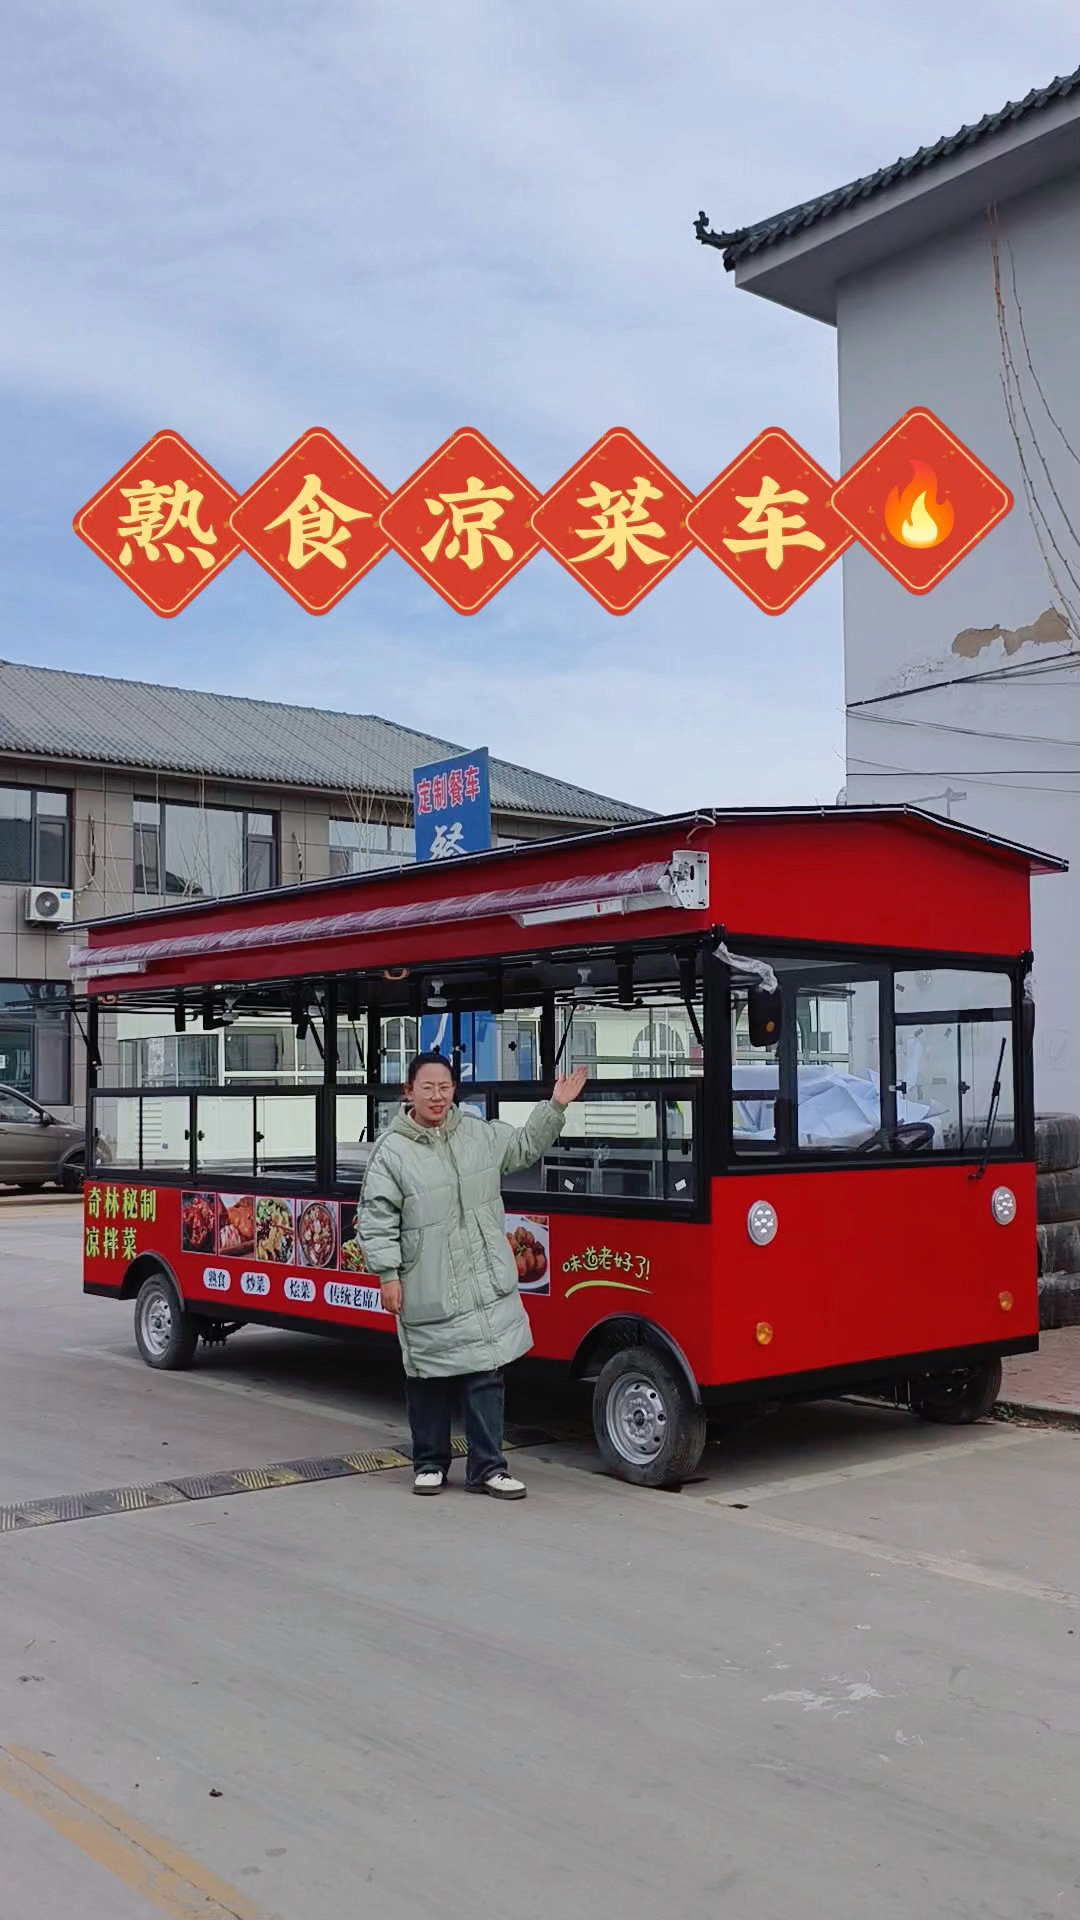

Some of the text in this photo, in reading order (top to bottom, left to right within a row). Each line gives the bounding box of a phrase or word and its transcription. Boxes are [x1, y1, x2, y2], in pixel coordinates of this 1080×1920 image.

[416, 765, 480, 815] 定制餐车
[87, 1186, 157, 1223] 奇林秘制
[85, 1226, 137, 1261] 凉拌菜
[562, 1245, 650, 1281] 味道老好了!
[208, 1269, 226, 1289] 熟食
[246, 1274, 265, 1293] 炒菜
[289, 1279, 311, 1300] 烩菜
